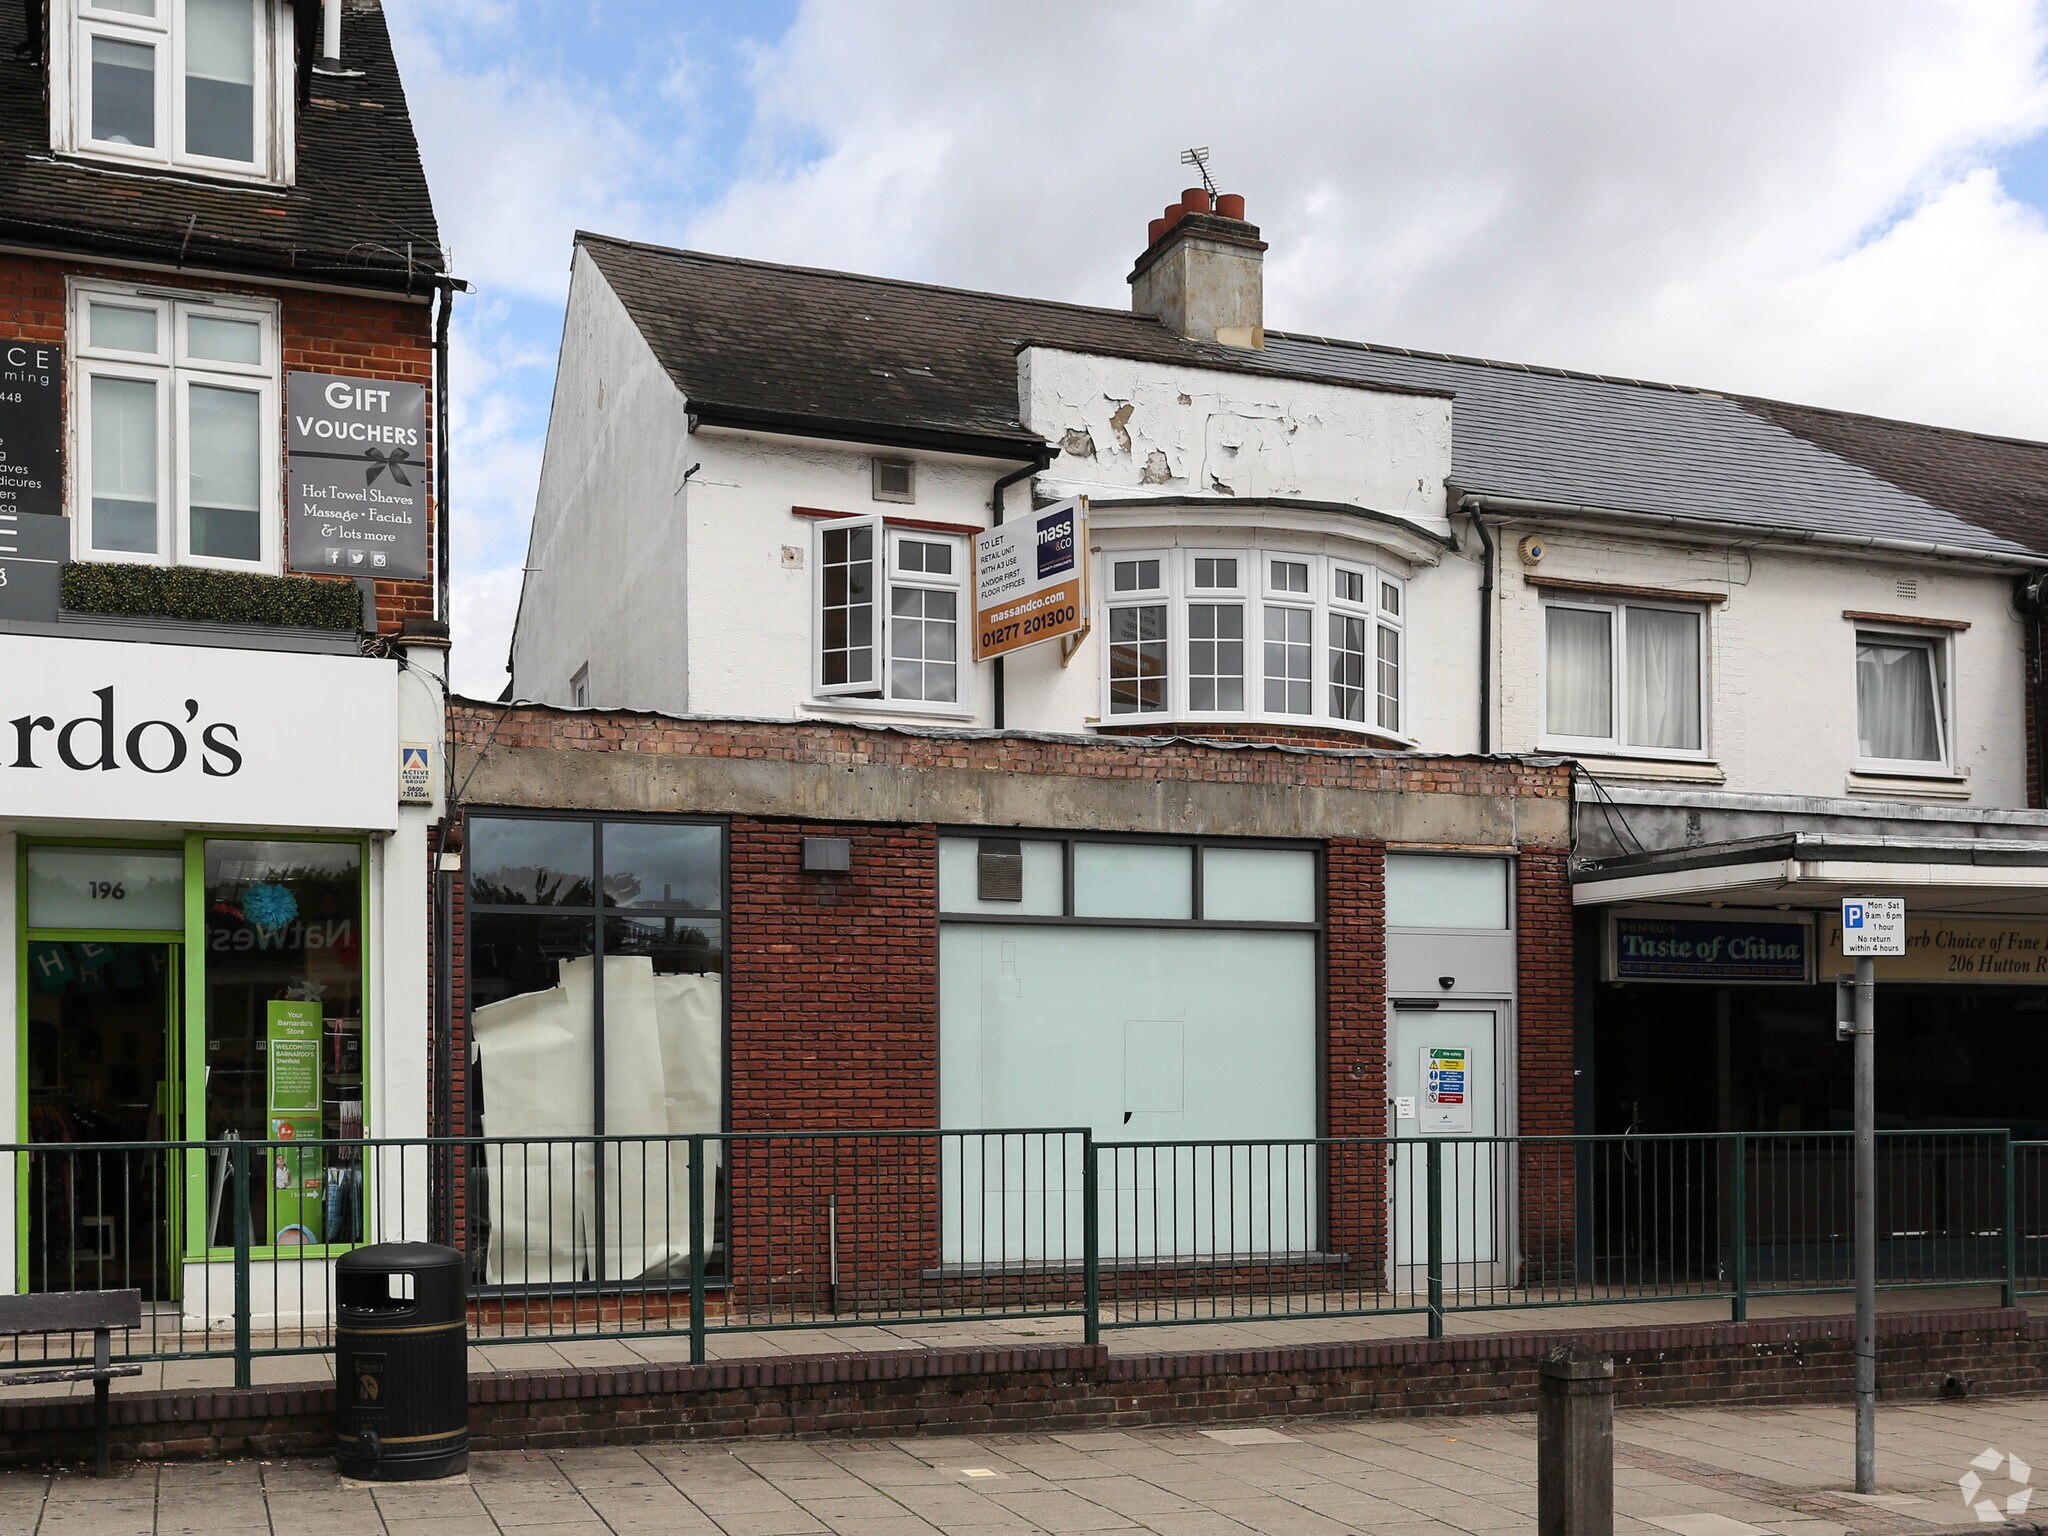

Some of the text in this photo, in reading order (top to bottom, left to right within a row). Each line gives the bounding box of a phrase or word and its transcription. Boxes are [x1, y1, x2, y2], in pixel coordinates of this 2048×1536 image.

[4, 370, 49, 387] ming
[324, 381, 390, 413] GIFT
[296, 416, 418, 446] VOUCHERS
[302, 484, 413, 506] Hot Towel Shaves
[303, 503, 413, 524] Massage Facials
[321, 524, 396, 542] & lots more
[1037, 520, 1072, 546] mass
[980, 535, 1004, 551] TO LET
[1055, 537, 1072, 551] &CO
[981, 545, 1015, 563] RETAIL UNIT
[981, 556, 1017, 575] WITH A3 USE
[981, 569, 1021, 589] AND/OR FIRST
[981, 577, 1026, 599] FLOOR OFFICES
[990, 591, 1065, 623] massandco.com
[982, 605, 1075, 648] 01277 201300
[0, 685, 243, 777] rdo's
[89, 881, 126, 900] 196
[1867, 901, 1882, 909] Mon
[1887, 901, 1900, 909] Sat
[1865, 911, 1870, 919] 9
[1886, 911, 1891, 919] 6
[1878, 923, 1894, 931] hour
[1623, 935, 1800, 962] Taste of China
[1849, 944, 1871, 952] within
[1880, 944, 1899, 952] hours
[1869, 935, 1891, 943] return
[1906, 930, 1930, 948] erb
[1936, 930, 1985, 949] Choice
[1989, 932, 2006, 953] of
[2008, 932, 2040, 950] Fine
[1948, 954, 1974, 973] 206
[1978, 955, 2030, 973] Hutton
